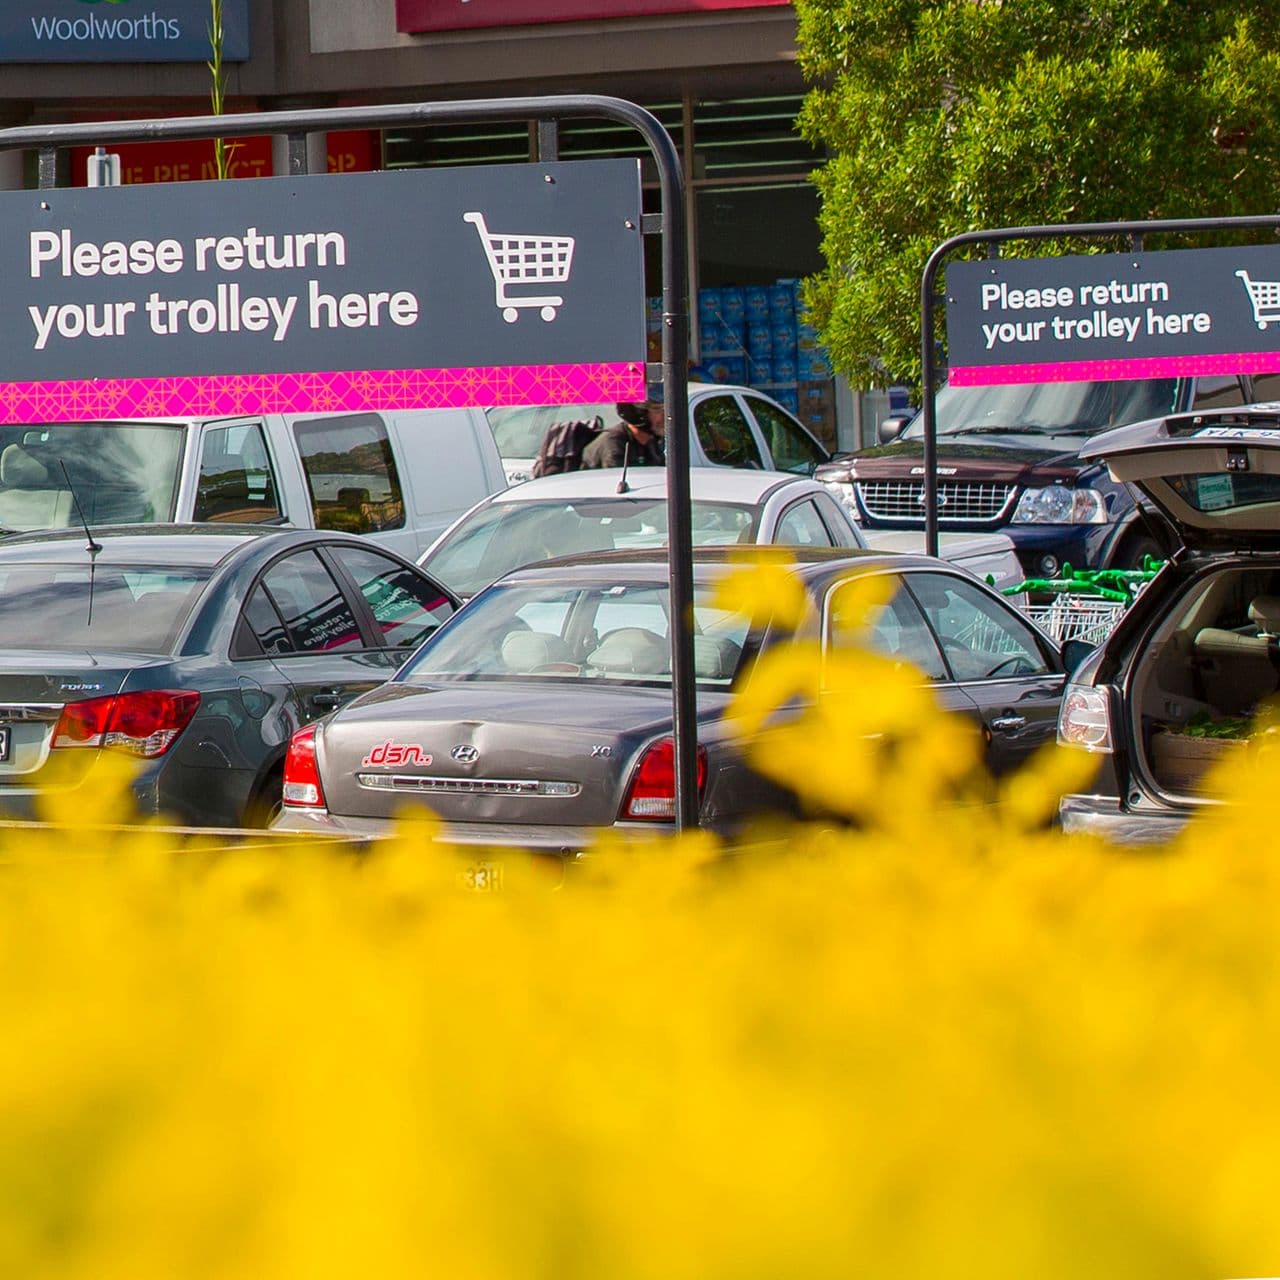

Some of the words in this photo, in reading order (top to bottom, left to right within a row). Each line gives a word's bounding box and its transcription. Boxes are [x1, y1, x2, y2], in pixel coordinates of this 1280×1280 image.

[31, 12, 181, 40] Woolworths
[29, 228, 183, 279] Please
[195, 226, 346, 272] return
[27, 300, 136, 350] your
[146, 283, 301, 342] trolley
[308, 280, 420, 328] here
[981, 282, 1074, 312] Please
[1080, 280, 1169, 306] return
[982, 321, 1046, 350] your
[1051, 310, 1141, 343] trolley
[1146, 308, 1211, 336] here
